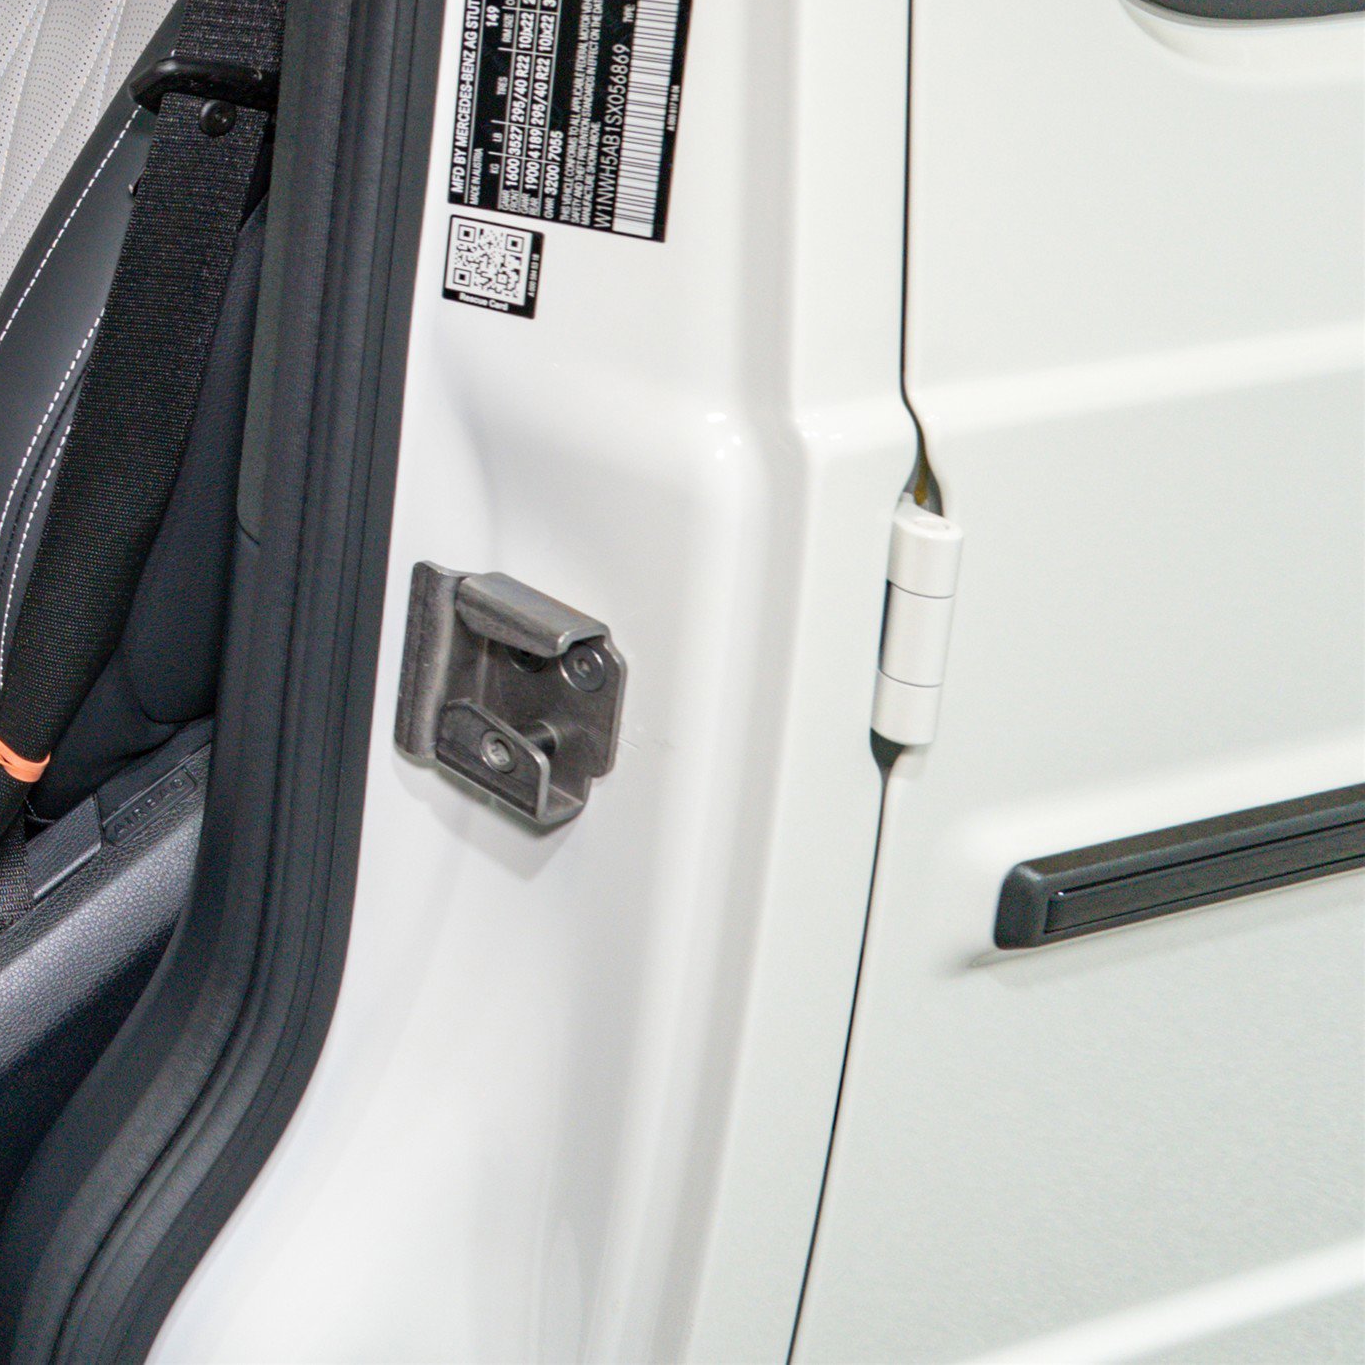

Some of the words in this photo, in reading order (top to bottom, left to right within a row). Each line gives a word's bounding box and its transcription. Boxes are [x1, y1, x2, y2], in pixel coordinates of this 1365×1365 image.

[486, 5, 500, 28] 149
[503, 13, 514, 28] SIZE
[579, 14, 591, 41] MOTOR
[591, 15, 602, 27] THE
[464, 31, 478, 49] AG
[502, 29, 512, 43] RIM
[519, 12, 535, 49] 10Jx22
[538, 15, 556, 52] 10Jx22
[589, 29, 600, 41] ON
[516, 55, 531, 78] R22
[576, 42, 588, 72] FEDERAL
[587, 41, 599, 66] EFFECT
[536, 57, 551, 81] R22
[586, 66, 596, 75] IN
[456, 50, 476, 147] MERCEDES-BENZ
[497, 76, 508, 96] TIRES
[571, 72, 585, 113] APPLICABLE
[582, 75, 595, 117] STANDARDS
[511, 79, 530, 123] 295/40
[531, 81, 550, 126] 295/40
[569, 126, 579, 136] TO
[570, 113, 581, 126] ALL
[493, 132, 503, 142] LB
[508, 125, 524, 156] 3527
[528, 128, 544, 159] 4189
[548, 130, 564, 162] 7055
[577, 118, 591, 161] PREVENTION
[594, 43, 630, 229] W1NWH5AB1SX056869
[454, 148, 467, 165] BY
[472, 147, 483, 176] AUSTRIA
[490, 163, 500, 174] KG
[565, 136, 578, 177] CONFORMS
[587, 147, 598, 174] SHOWN
[452, 166, 466, 193] MFD
[472, 176, 481, 185] IN
[505, 158, 521, 187] 1600
[525, 161, 540, 191] 1900
[545, 164, 560, 196] 3200
[575, 162, 587, 182] THEFT
[470, 185, 480, 205] MADE
[562, 177, 574, 205] VEHICLE
[573, 182, 584, 198] AND
[581, 174, 595, 226] MANUFACTURE
[544, 197, 555, 219] GVWR
[561, 205, 571, 222] THIS
[571, 198, 583, 224] SAFETY
[460, 292, 488, 306] Rescue
[489, 299, 508, 311] Card
